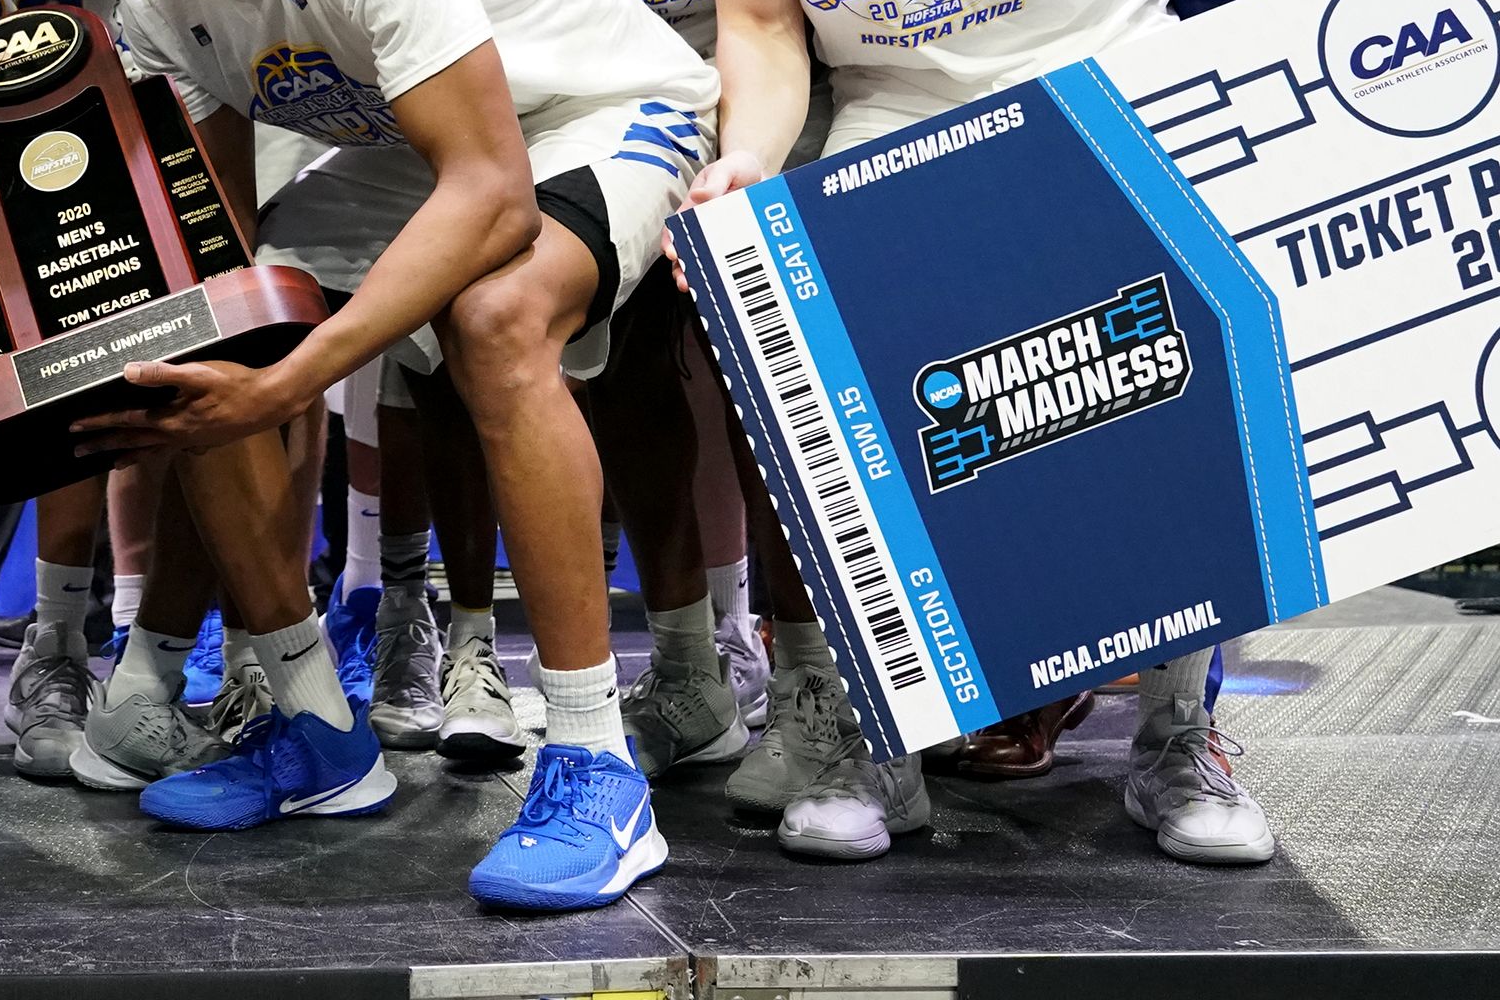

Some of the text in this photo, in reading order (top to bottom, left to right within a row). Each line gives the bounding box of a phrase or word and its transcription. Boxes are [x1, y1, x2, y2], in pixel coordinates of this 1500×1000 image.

[869, 1, 898, 21] 20
[861, 21, 953, 47] HOFSTRA
[1350, 8, 1473, 80] CAA
[271, 69, 334, 100] CAA
[1354, 43, 1488, 99] COLONIAL ATHLETIC ASSOCIATION
[34, 153, 79, 175] HOFSTRA
[167, 155, 193, 167] UNIVERSITY
[822, 102, 1025, 197] #MARCHMADNESS
[171, 178, 210, 194] NORTH CAROLINA
[172, 174, 198, 188] UNIVERSITY
[57, 202, 92, 225] 2020
[180, 203, 220, 221] NORTHEASTERN
[187, 211, 217, 225] UNIVERSITY
[56, 221, 106, 249] MEN'S
[199, 239, 229, 254] UNIVERSITY
[200, 235, 224, 247] TOWSON
[1276, 174, 1454, 288] TICKET
[37, 234, 140, 279] BASKETBALL
[763, 202, 820, 301] SEAT 20
[49, 256, 142, 299] CHAMPIONS
[58, 288, 151, 328] TOM YEAGER
[40, 313, 193, 379] HOFSTRA UNIVERSITY
[962, 316, 1102, 404] MARCH
[929, 383, 963, 404] NCAA
[994, 334, 1184, 439] MADNESS
[837, 386, 891, 481] ROW 15
[909, 566, 980, 704] SECTION 3
[1030, 600, 1221, 689] NCAA.COM/MML
